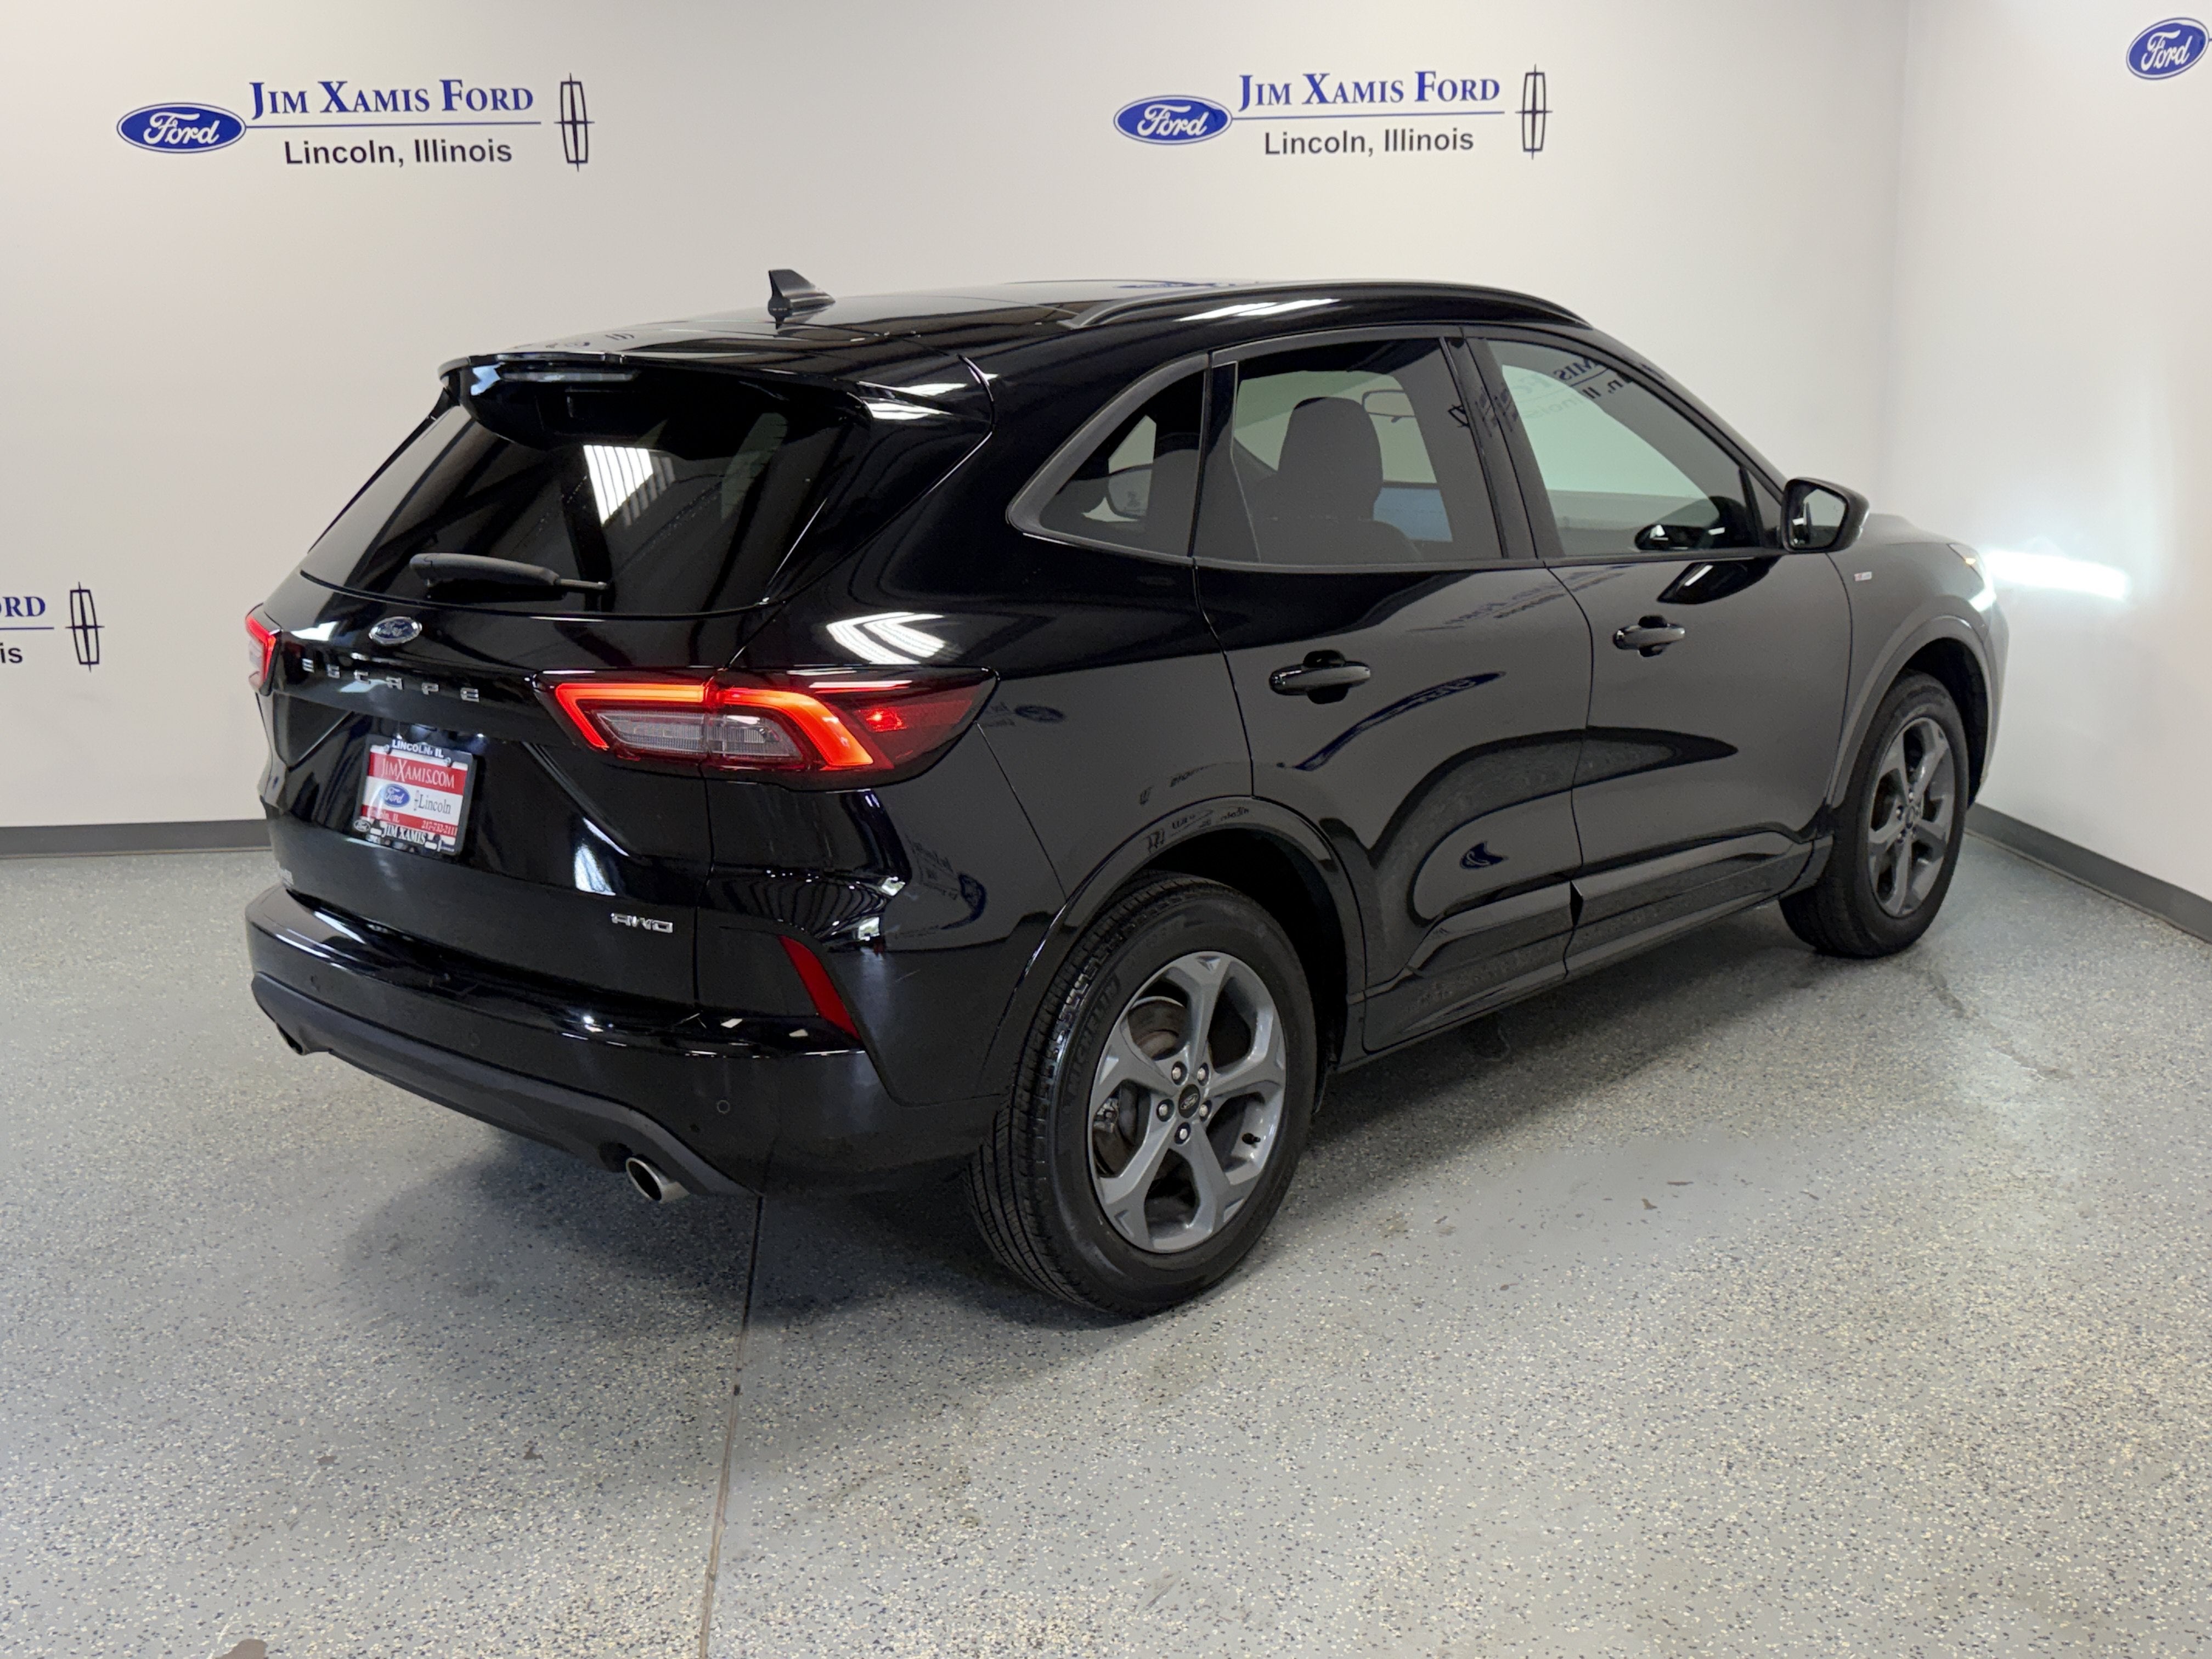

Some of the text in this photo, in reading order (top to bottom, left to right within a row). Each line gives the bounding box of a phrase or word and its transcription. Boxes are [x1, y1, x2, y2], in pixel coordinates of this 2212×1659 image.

[2141, 29, 2193, 71] Ford
[249, 79, 534, 121] JIM XAMIS FORD
[1238, 71, 1500, 112] JIM XAMIS FORD
[143, 111, 221, 146] Ford
[1137, 104, 1209, 137] Ford
[284, 138, 512, 168] Lincoln, Illinois
[1265, 127, 1474, 157] Lincoln, Illinois
[0, 596, 46, 617] RD
[302, 658, 480, 703] ESCAPE
[435, 747, 444, 759] IL
[385, 786, 404, 804] Ford
[418, 794, 452, 815] Lincoln
[381, 824, 427, 845] JIM XAMIS
[610, 912, 674, 933] AWD
